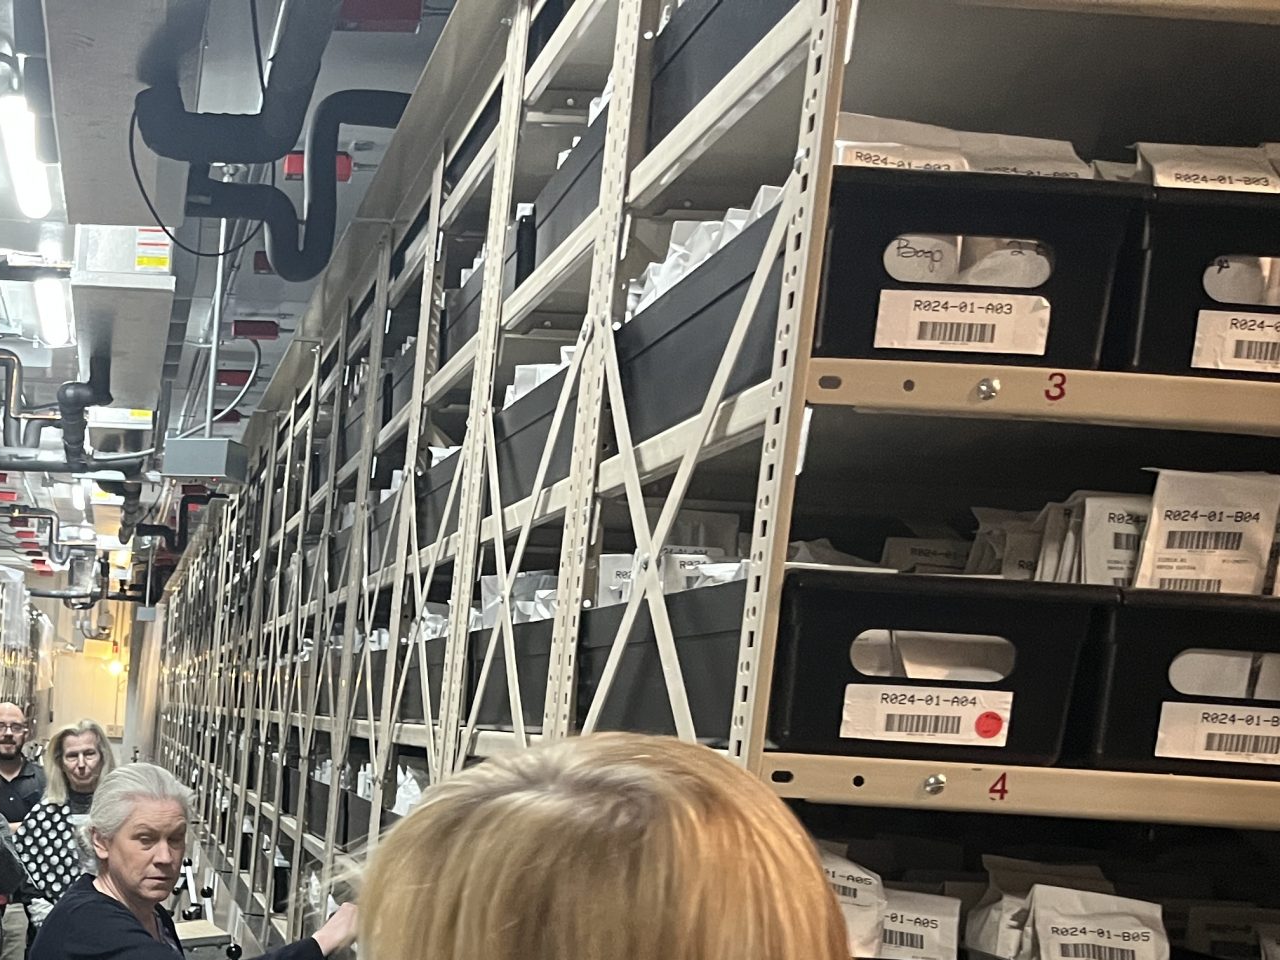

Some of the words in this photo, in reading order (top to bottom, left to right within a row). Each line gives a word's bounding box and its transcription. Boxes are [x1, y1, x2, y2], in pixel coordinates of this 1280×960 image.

[913, 300, 1013, 315] R024-01-A03
[1045, 372, 1067, 401] 3
[1163, 509, 1261, 523] R024-01-B04
[880, 693, 977, 707] R024-01-A04
[988, 772, 1008, 800] 4
[1050, 926, 1151, 942] R024-01-B05
